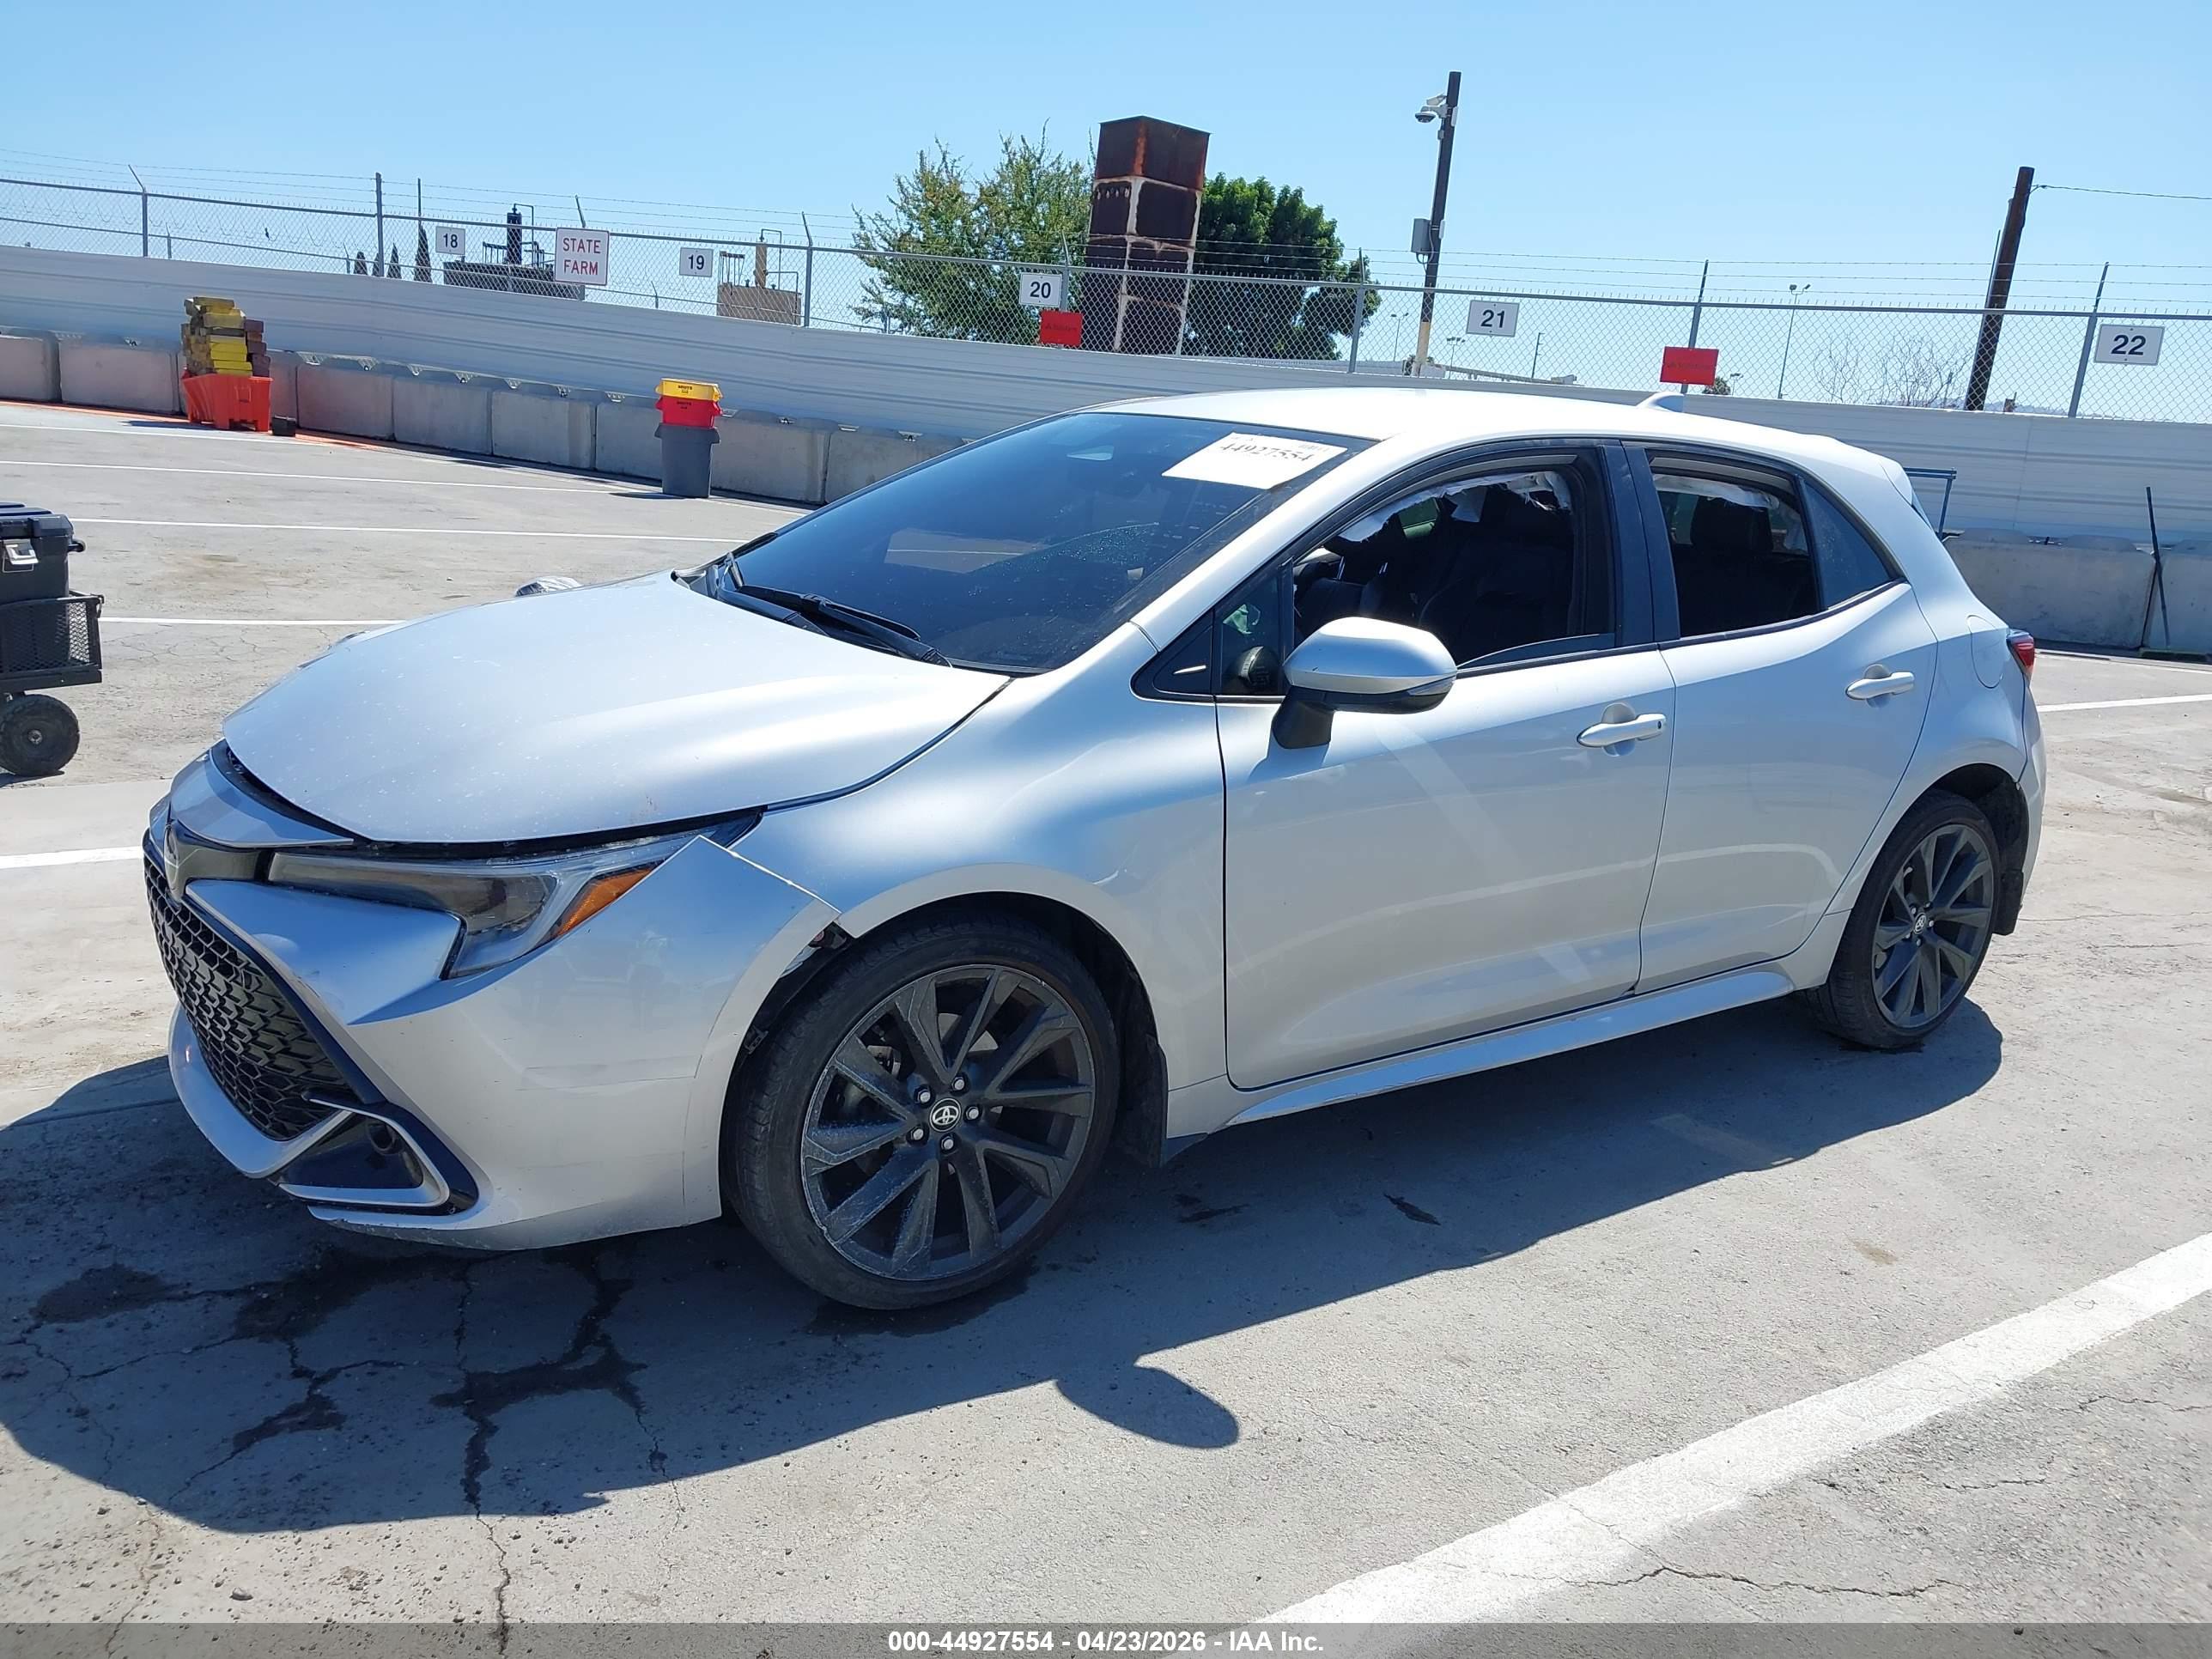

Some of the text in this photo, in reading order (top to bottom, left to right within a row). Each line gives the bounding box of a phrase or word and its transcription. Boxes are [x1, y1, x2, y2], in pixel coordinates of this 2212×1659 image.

[443, 233, 459, 248] 18
[562, 237, 601, 254] STATE
[563, 259, 599, 276] FARM
[688, 254, 705, 270] 19
[1030, 281, 1051, 299] 20
[1480, 309, 1505, 328] 21
[2111, 334, 2147, 356] 22
